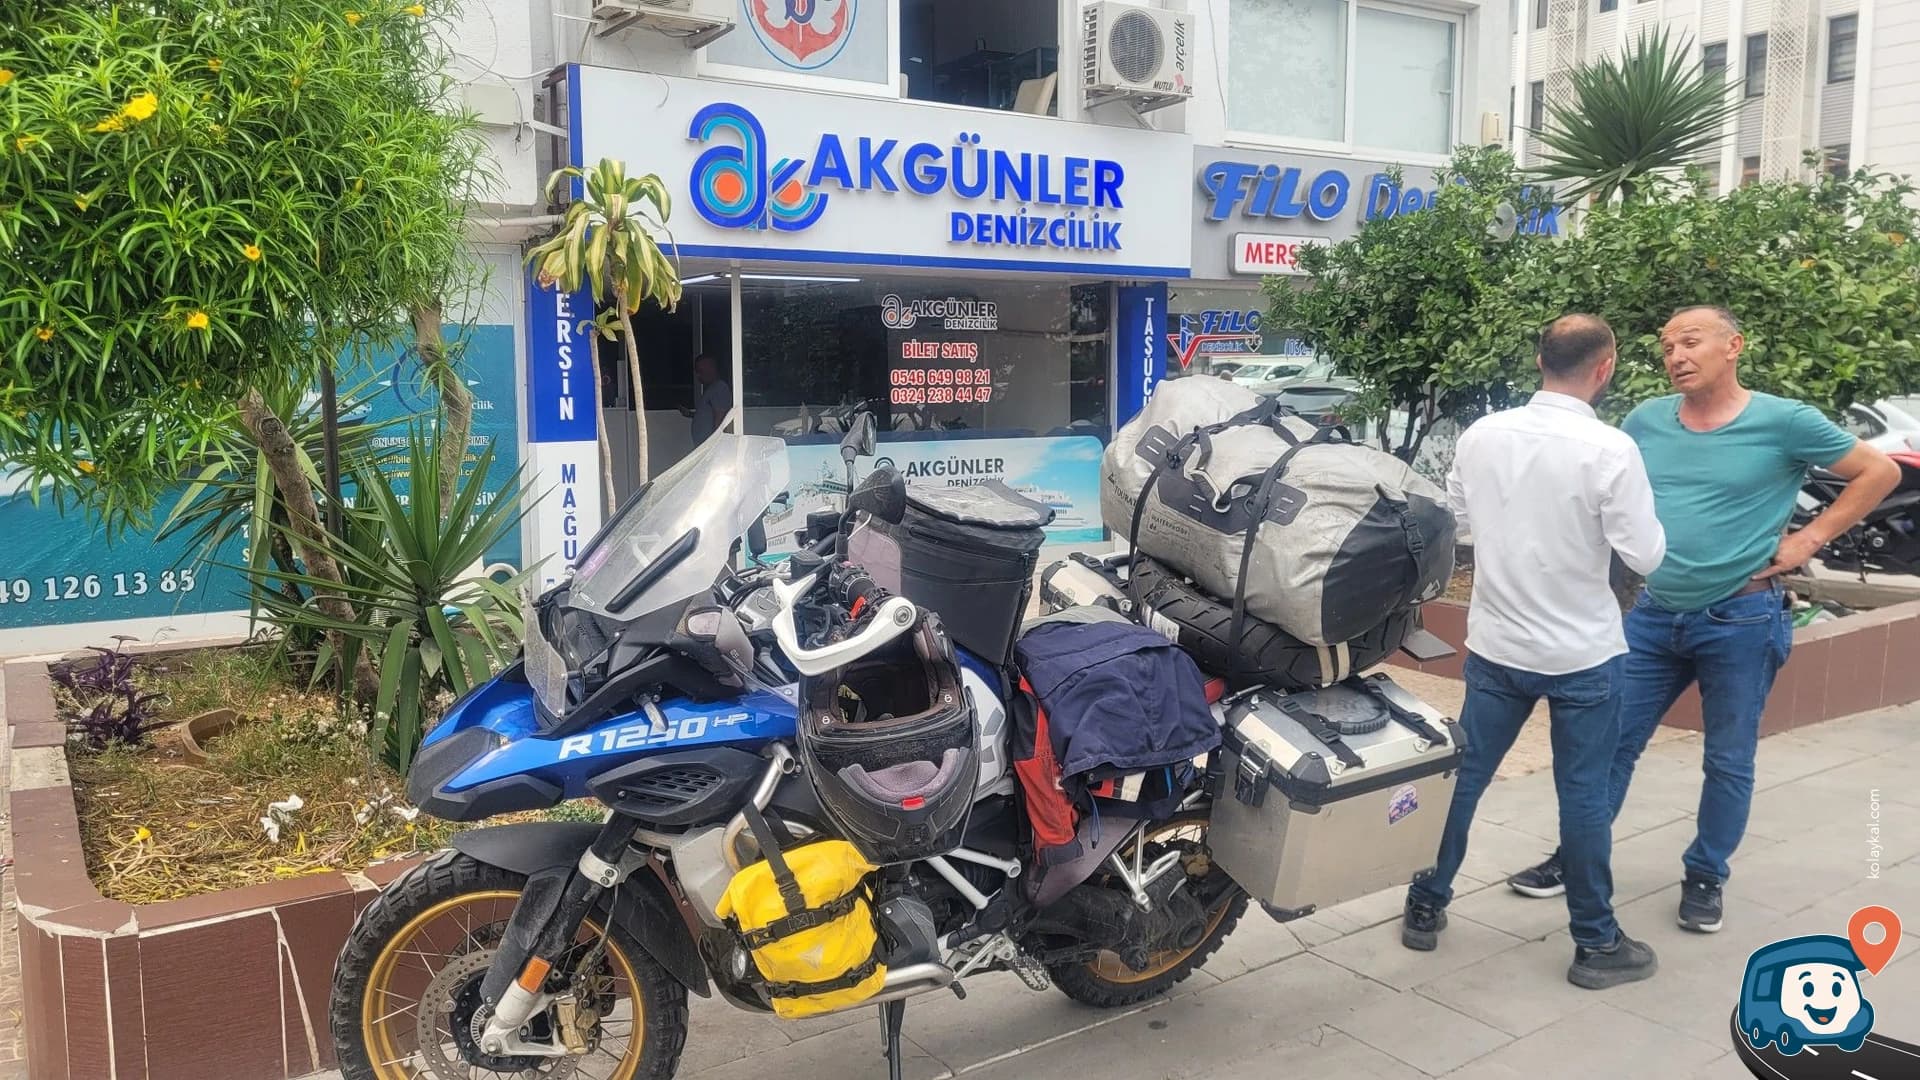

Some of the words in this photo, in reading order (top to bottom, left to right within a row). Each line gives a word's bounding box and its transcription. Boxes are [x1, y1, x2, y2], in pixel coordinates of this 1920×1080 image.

[1174, 18, 1188, 72] arçelik
[807, 131, 1125, 209] AKGÜNLER
[951, 207, 1122, 250] DENİZCİLİK
[909, 297, 998, 318] AKGÜNLER
[944, 318, 998, 330] DENİZCİLİK
[903, 338, 940, 359] BİLET
[942, 343, 978, 363] SATIŞ
[891, 369, 925, 386] 0546
[928, 369, 953, 386] 649
[955, 369, 973, 386] 98
[975, 368, 991, 385] 21
[891, 387, 925, 404] 0324
[928, 387, 953, 404] 238
[955, 387, 973, 403] 44
[975, 387, 992, 403] 47
[906, 456, 1004, 478] AKGÜNLER
[43, 574, 101, 600] 126
[113, 571, 148, 596] 13
[160, 568, 196, 593] 85
[559, 735, 593, 760] R
[600, 716, 708, 751] 1250
[712, 712, 754, 728] HP
